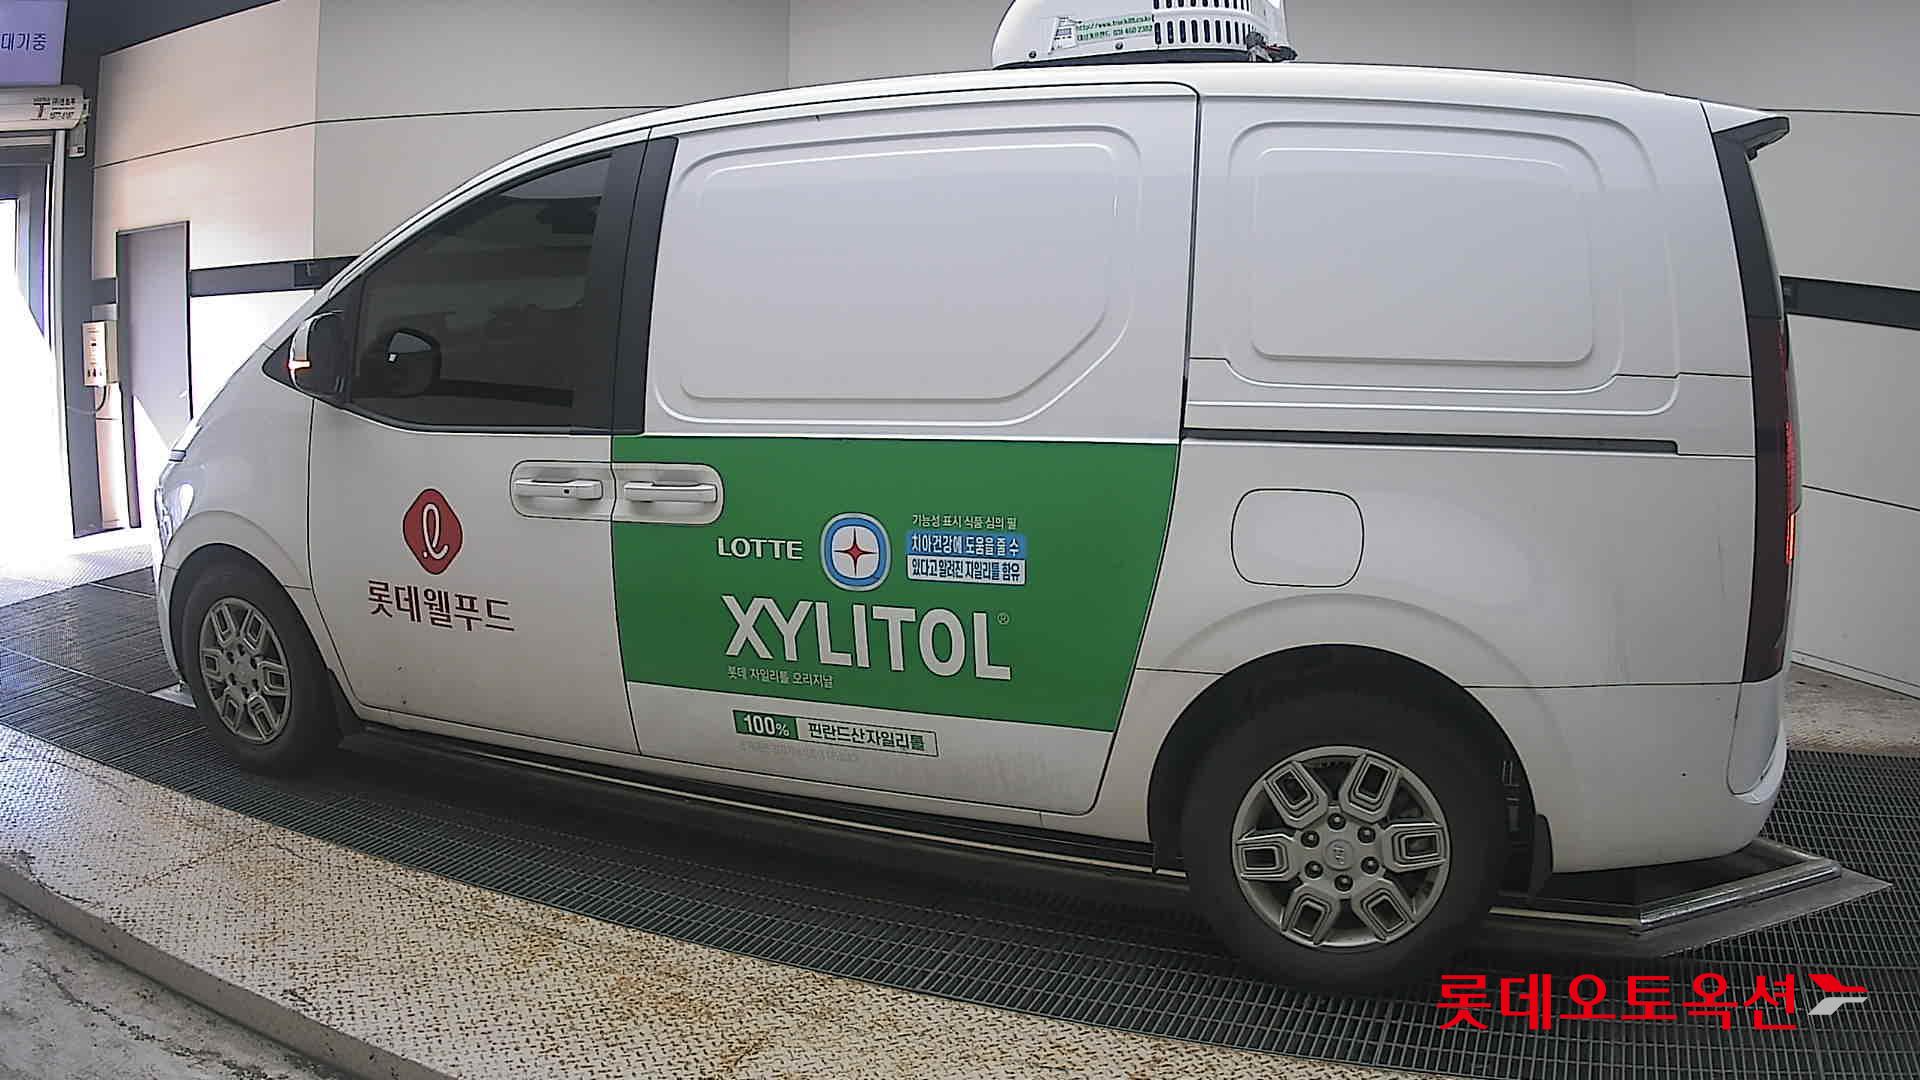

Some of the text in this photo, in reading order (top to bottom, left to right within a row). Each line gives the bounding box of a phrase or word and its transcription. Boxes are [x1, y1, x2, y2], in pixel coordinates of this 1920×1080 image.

[1, 32, 48, 51] 대기중
[717, 537, 803, 560] LOTTE
[966, 536, 995, 556] 도움을
[1009, 538, 1020, 557] 수
[368, 580, 515, 631] 롯데웰푸드
[721, 595, 1012, 681] XYLITOL
[743, 714, 790, 738] 100%
